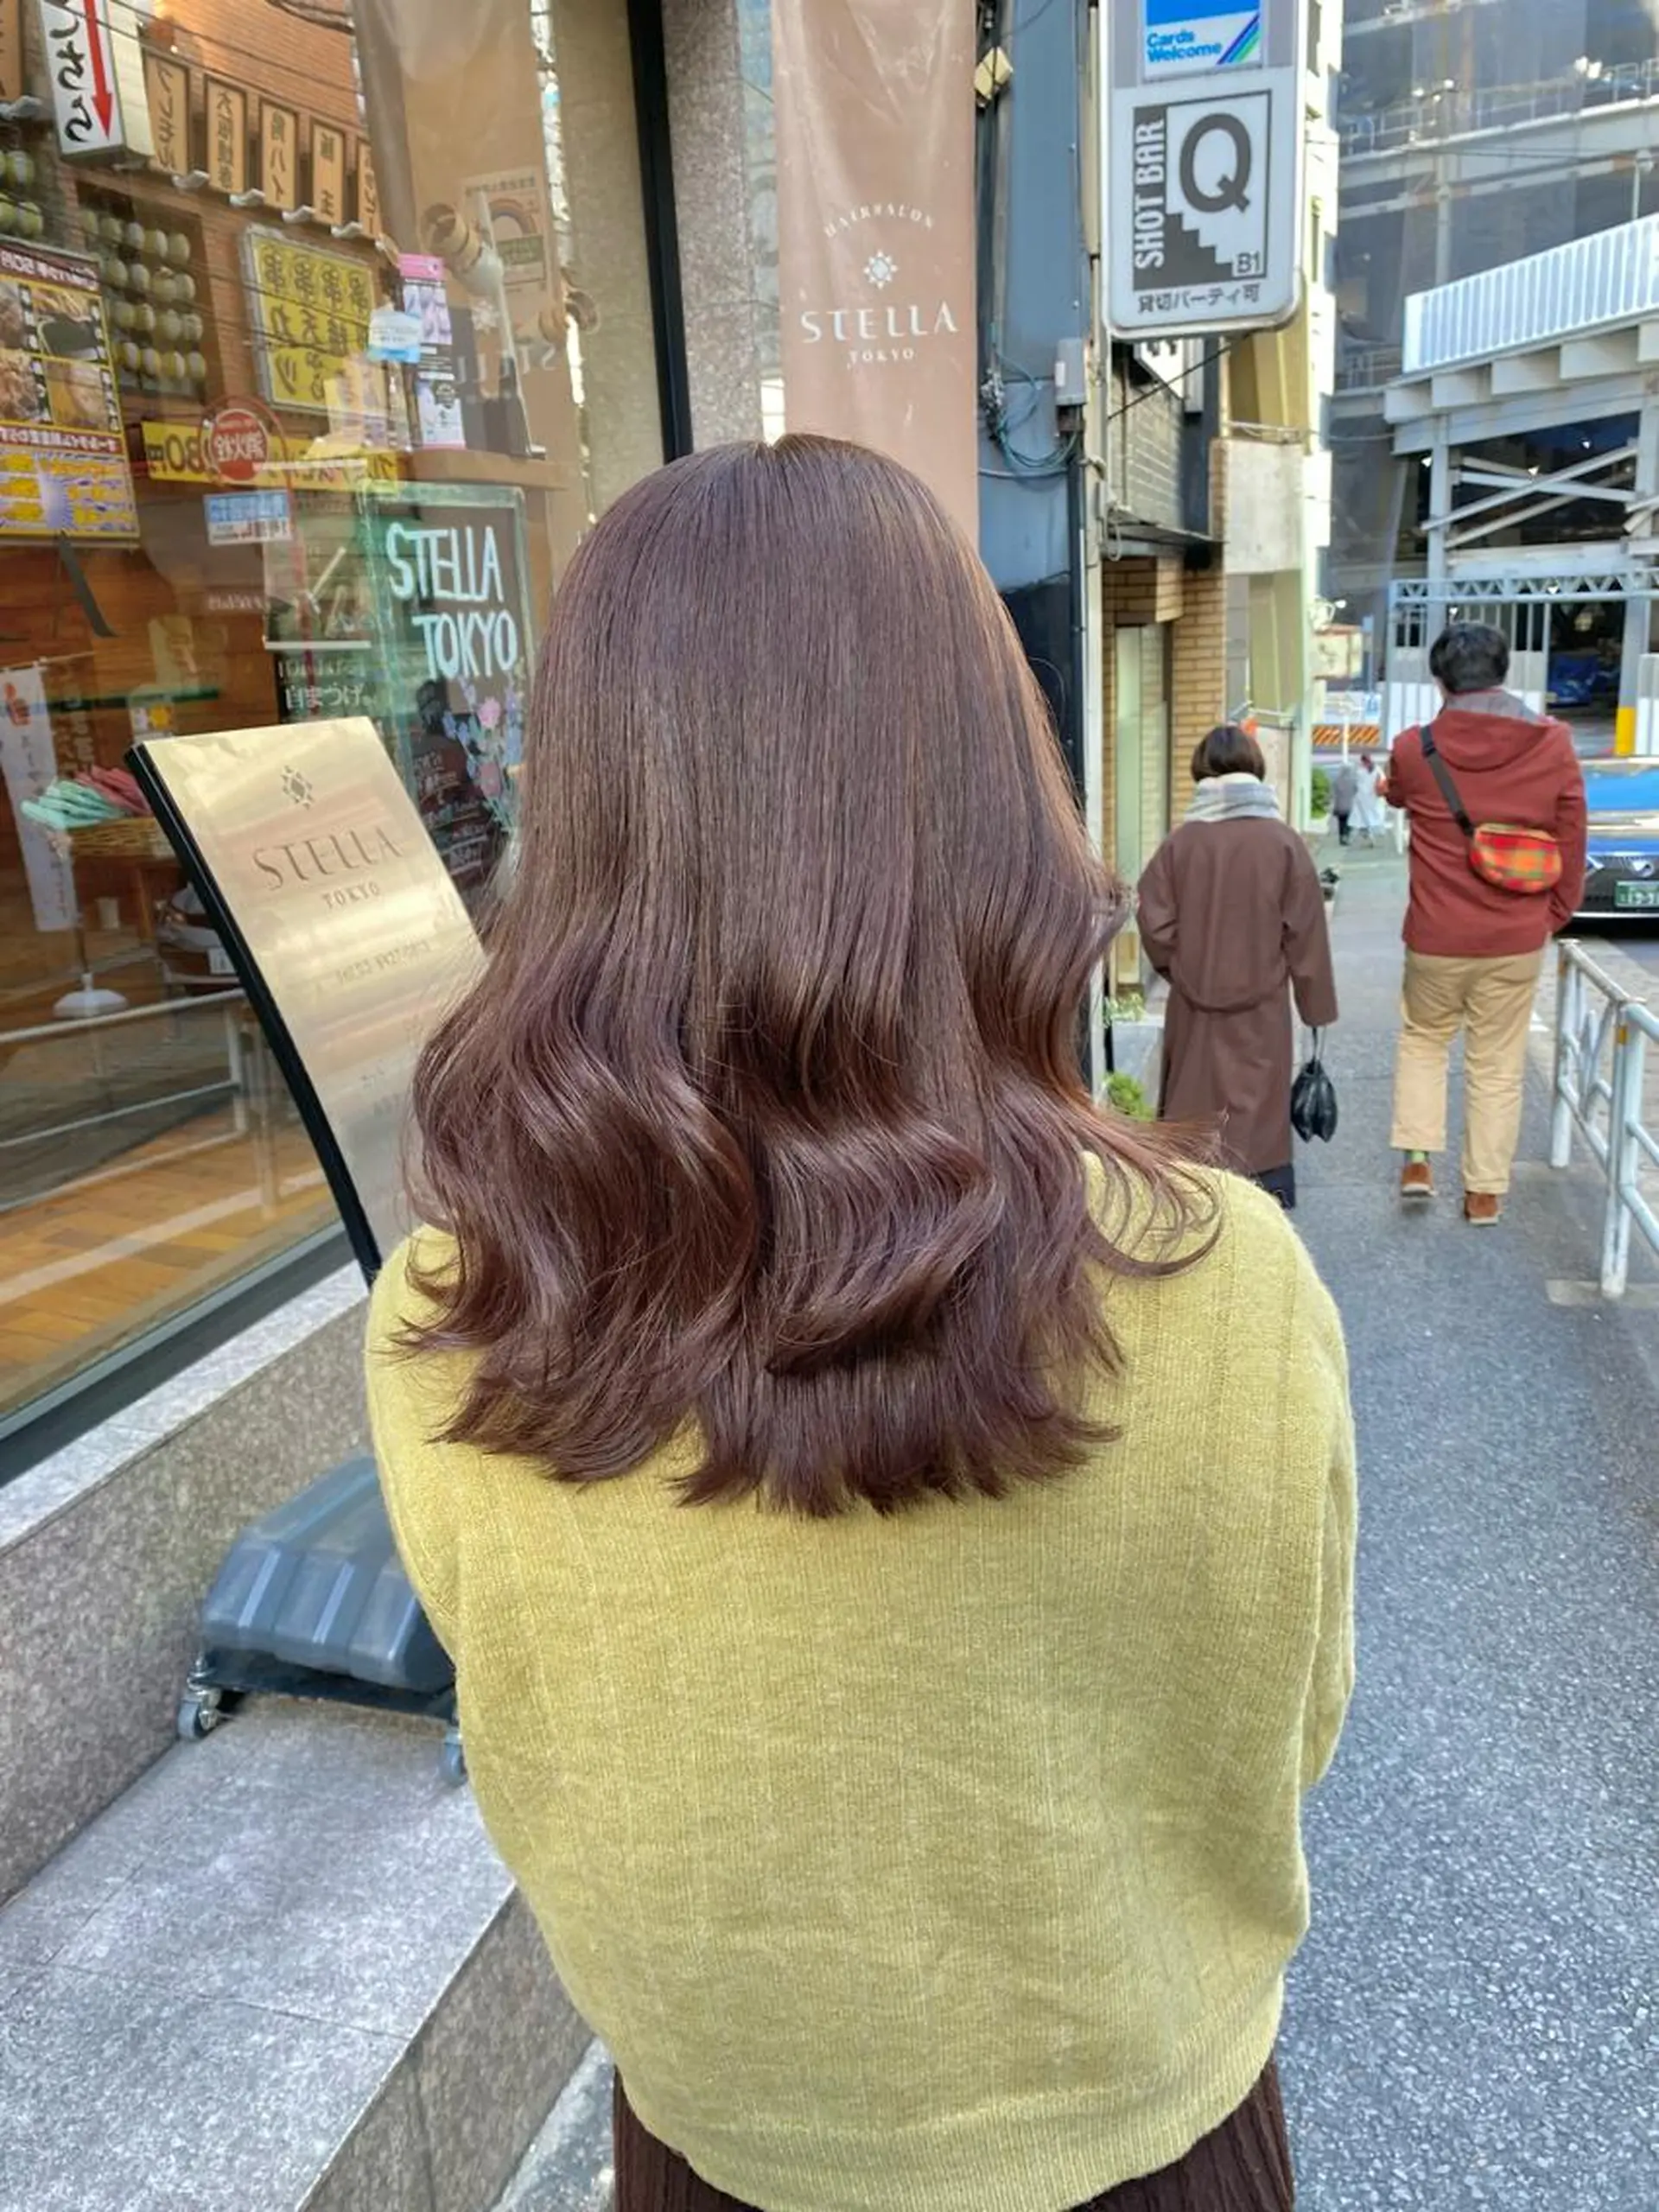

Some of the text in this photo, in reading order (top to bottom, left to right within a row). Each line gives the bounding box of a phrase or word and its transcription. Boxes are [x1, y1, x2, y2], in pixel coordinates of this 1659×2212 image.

[1147, 29, 1194, 48] Cards
[1147, 42, 1222, 63] Welcome
[1135, 118, 1165, 185] BAR
[1179, 112, 1252, 213] Q
[1135, 194, 1165, 270] SHOT
[1236, 251, 1260, 273] B1
[800, 301, 960, 344] STELLA
[848, 348, 916, 365] TOKYO
[386, 522, 504, 603] STELLA
[411, 609, 518, 681] TOKYO
[253, 825, 404, 891] STELLA
[322, 880, 380, 909] TOKYO
